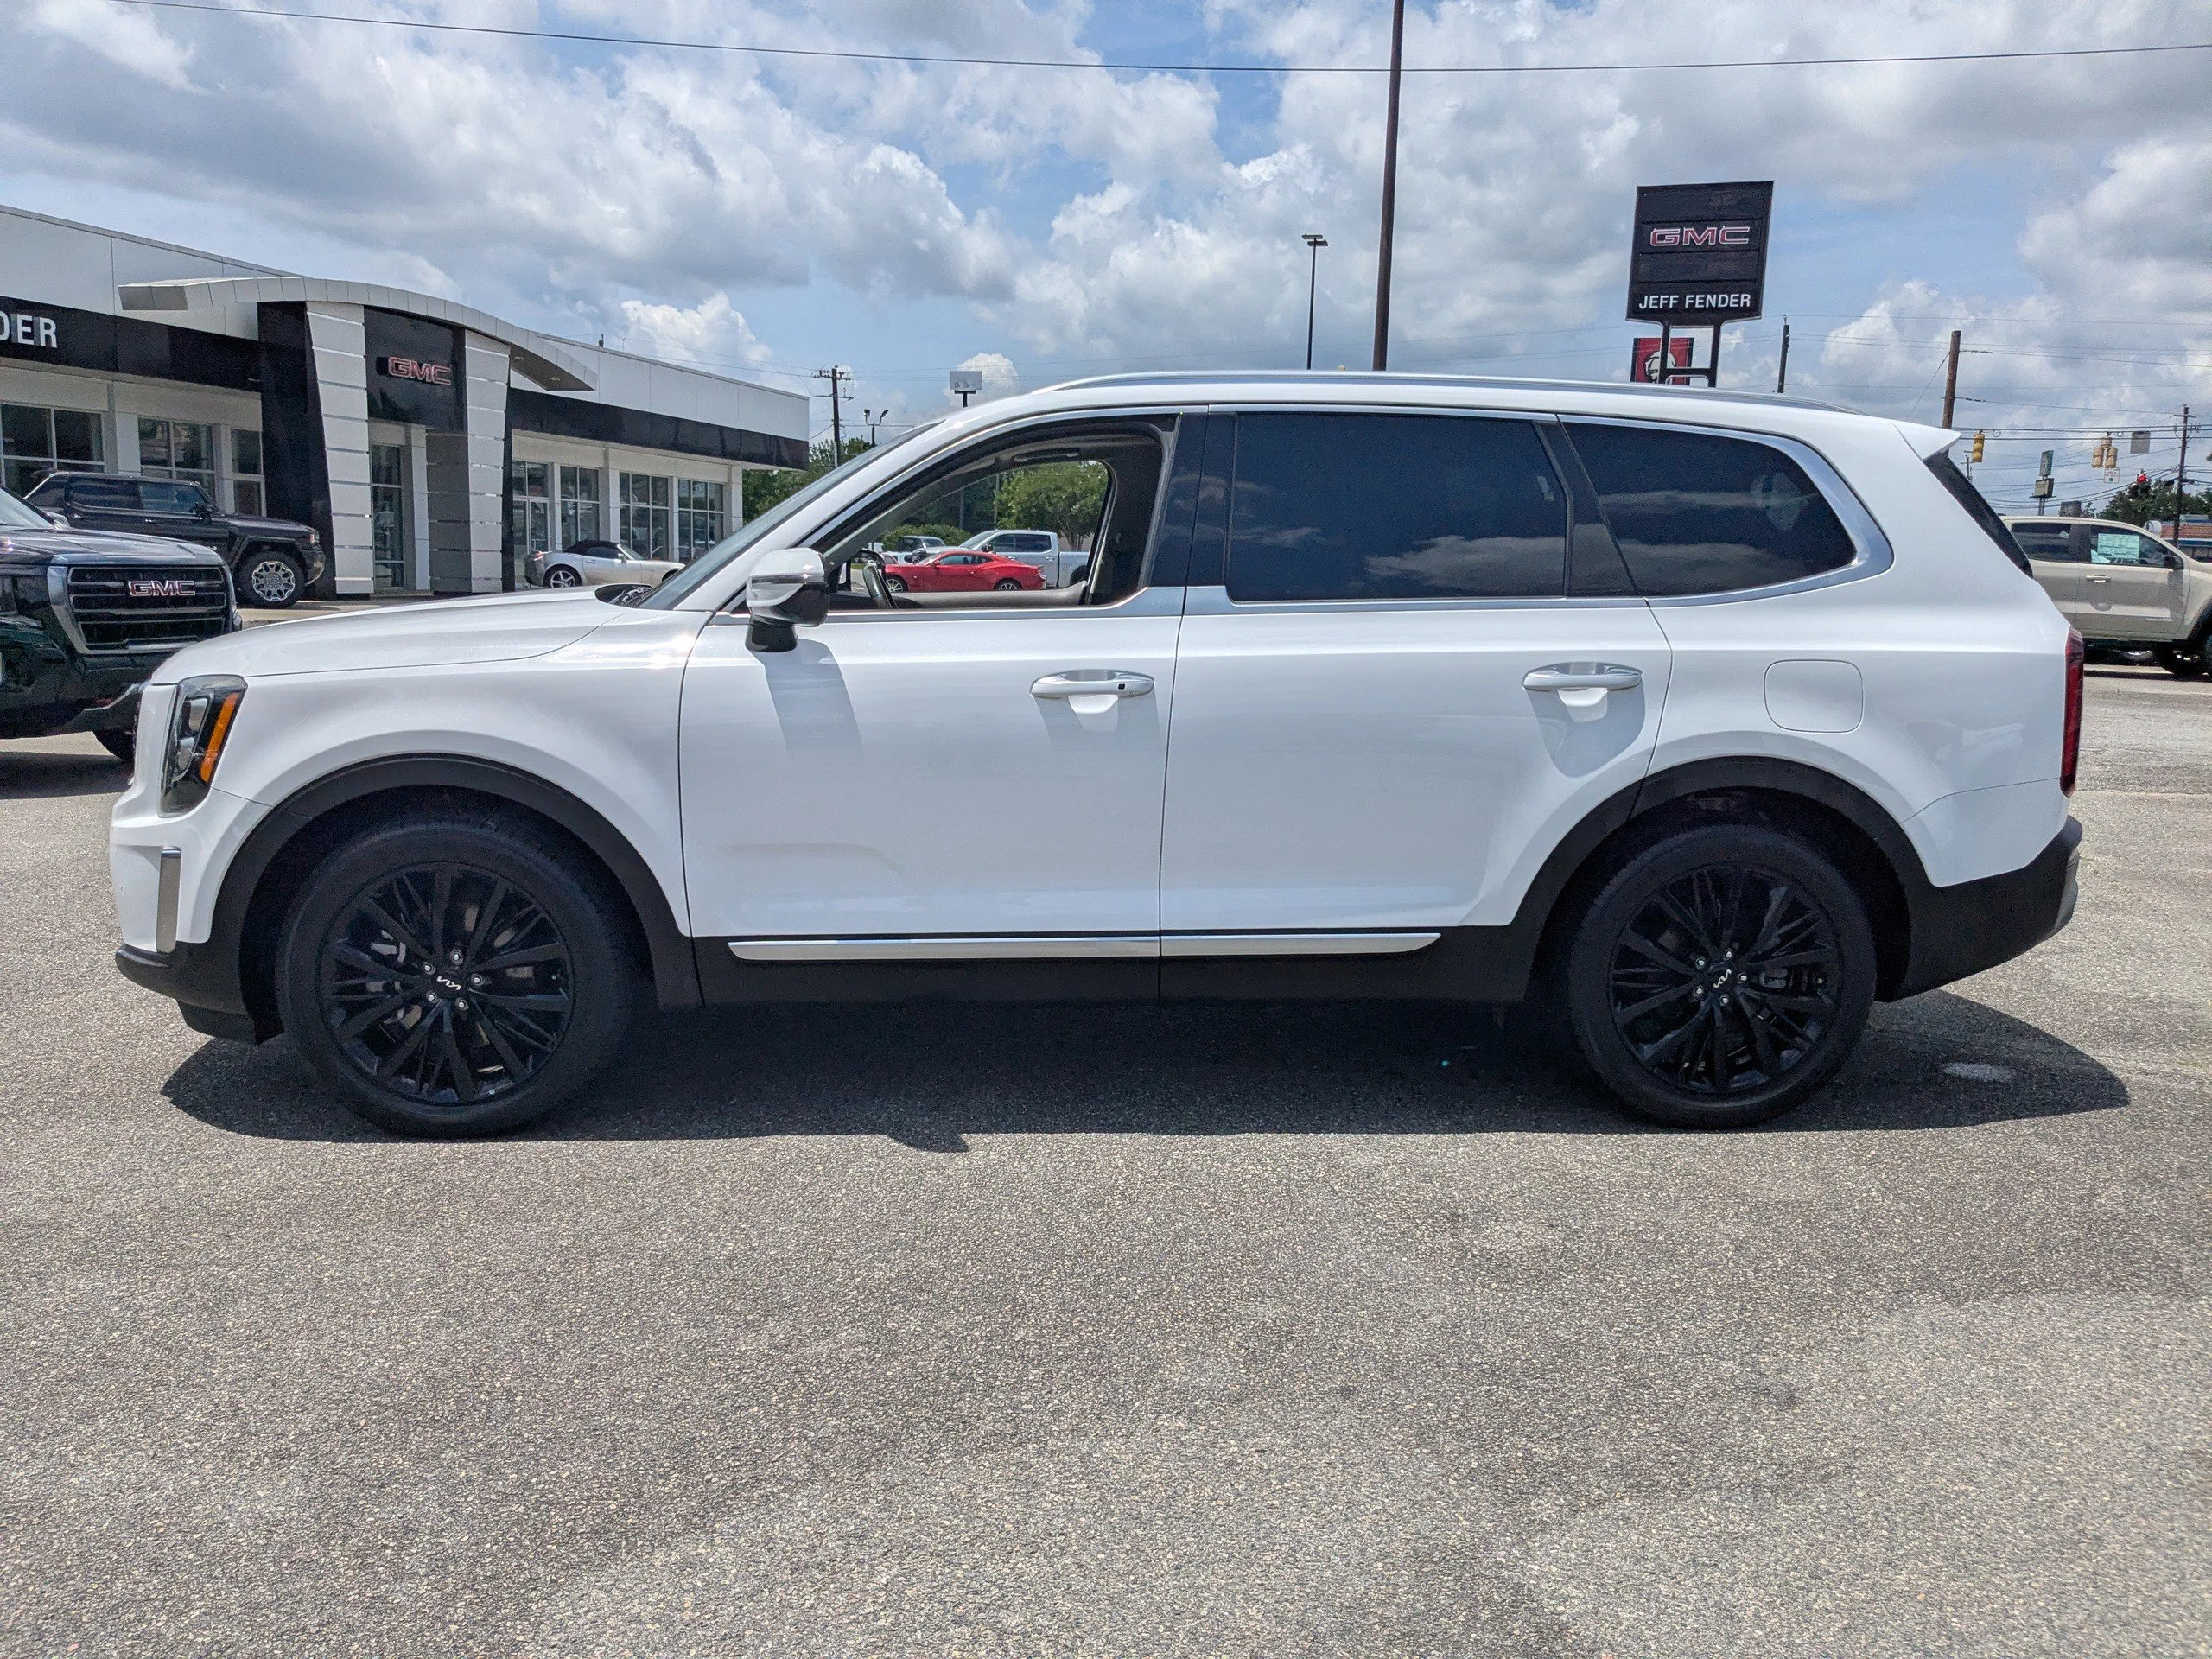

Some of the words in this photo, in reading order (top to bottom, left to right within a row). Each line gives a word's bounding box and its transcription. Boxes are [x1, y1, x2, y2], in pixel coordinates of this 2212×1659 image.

[1649, 226, 1751, 247] GMC
[1638, 295, 1679, 309] JEFF
[1685, 293, 1751, 309] FENDER
[388, 356, 452, 385] GMC
[128, 580, 196, 597] GMC
